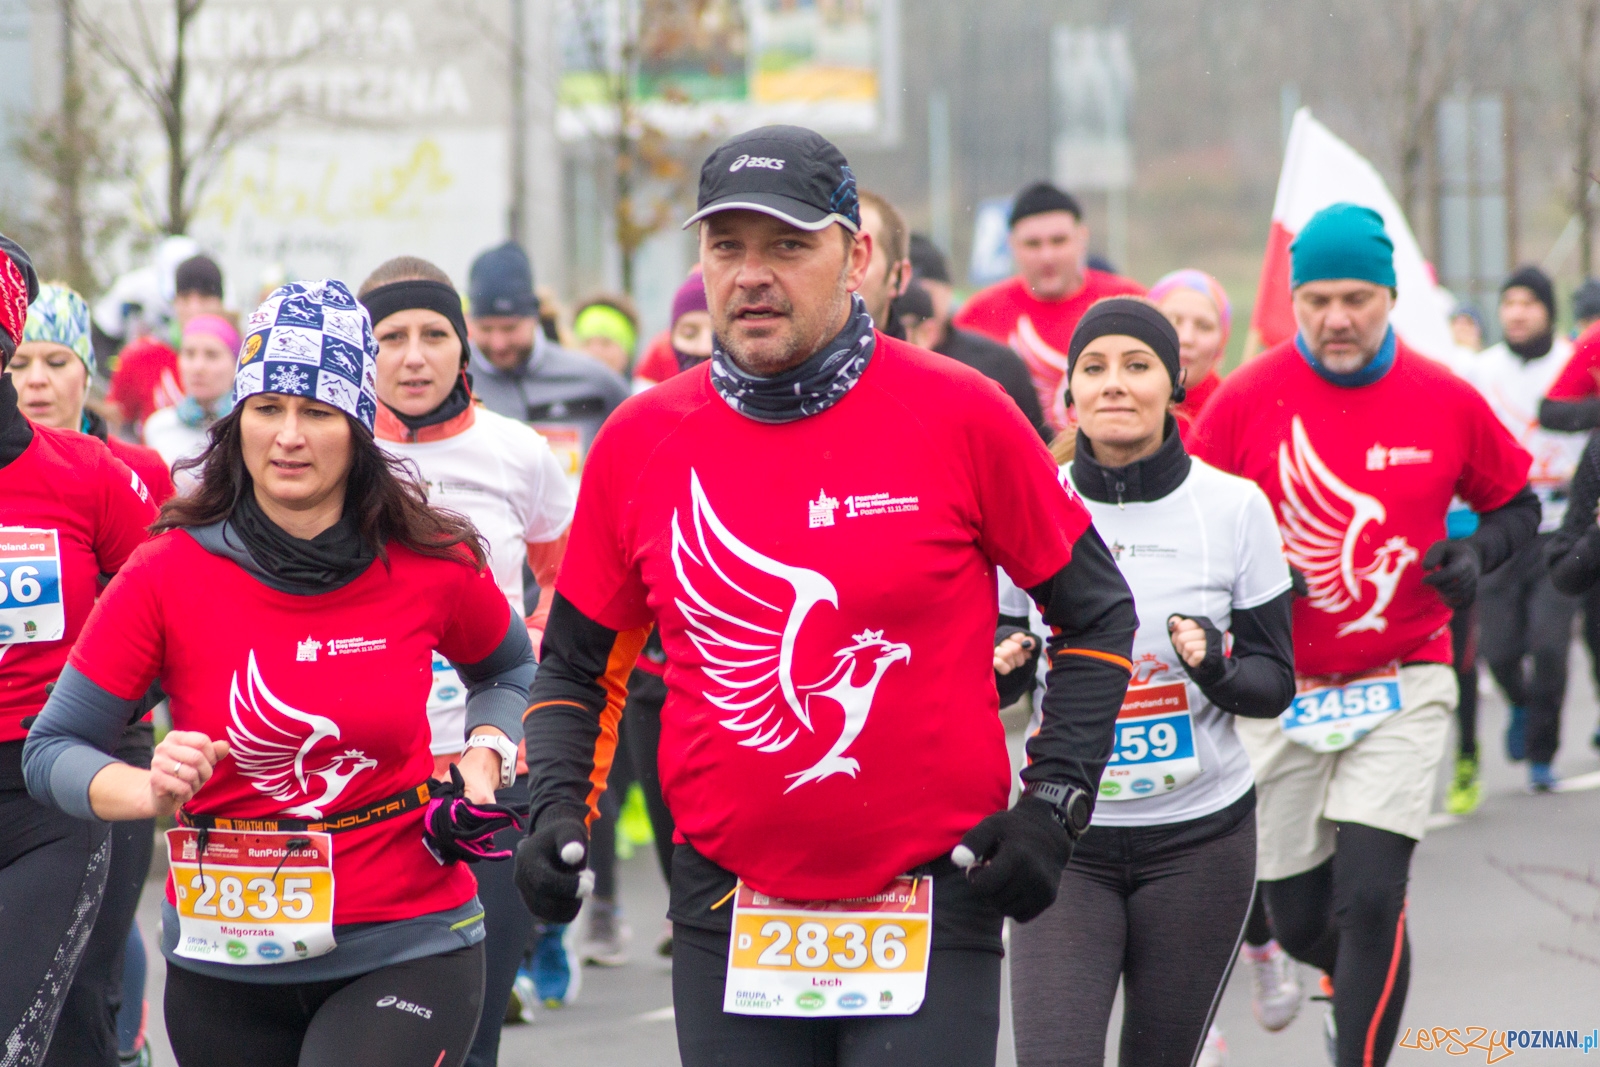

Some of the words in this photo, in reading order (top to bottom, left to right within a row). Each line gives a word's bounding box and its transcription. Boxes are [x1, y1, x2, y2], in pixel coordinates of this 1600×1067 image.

[844, 495, 858, 517] 1
[0, 542, 45, 551] oland.org
[327, 639, 337, 656] 1
[1297, 685, 1390, 724] 3458
[233, 819, 279, 832] TRIATHLON
[178, 885, 187, 900] D
[190, 874, 314, 919] 2835
[738, 933, 752, 950] D
[756, 919, 908, 970] 2836
[812, 976, 842, 987] Lech
[736, 990, 766, 1000] GRUPA
[735, 999, 772, 1009] LUXMED
